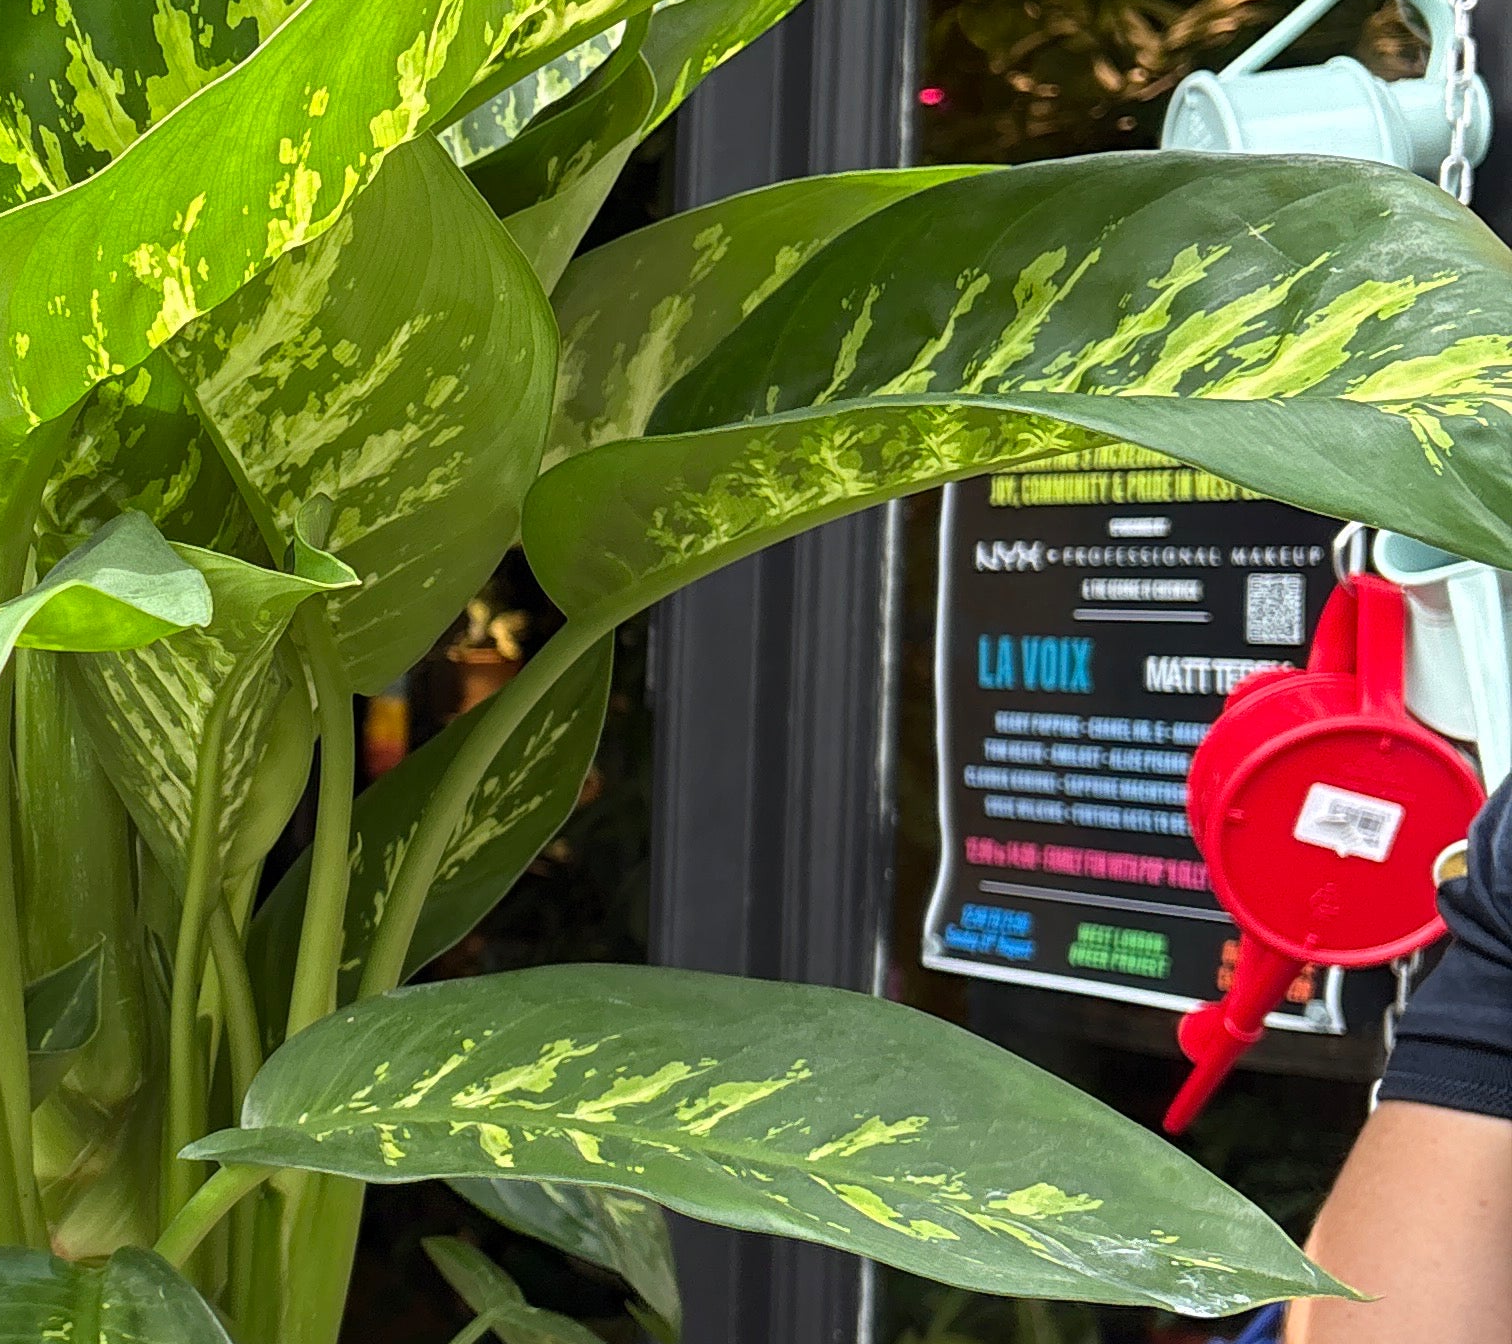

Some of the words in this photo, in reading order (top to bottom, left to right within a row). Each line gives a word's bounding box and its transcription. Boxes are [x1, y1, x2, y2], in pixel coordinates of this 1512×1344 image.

[1021, 472, 1112, 505] COMMUNITY
[1126, 470, 1175, 503] PRIDE
[1061, 545, 1223, 567] PROFESSIONAL
[1231, 545, 1325, 567] MAKEUP
[978, 633, 1015, 690] LA
[1021, 634, 1094, 694] VOIX
[1146, 655, 1210, 695] MATT
